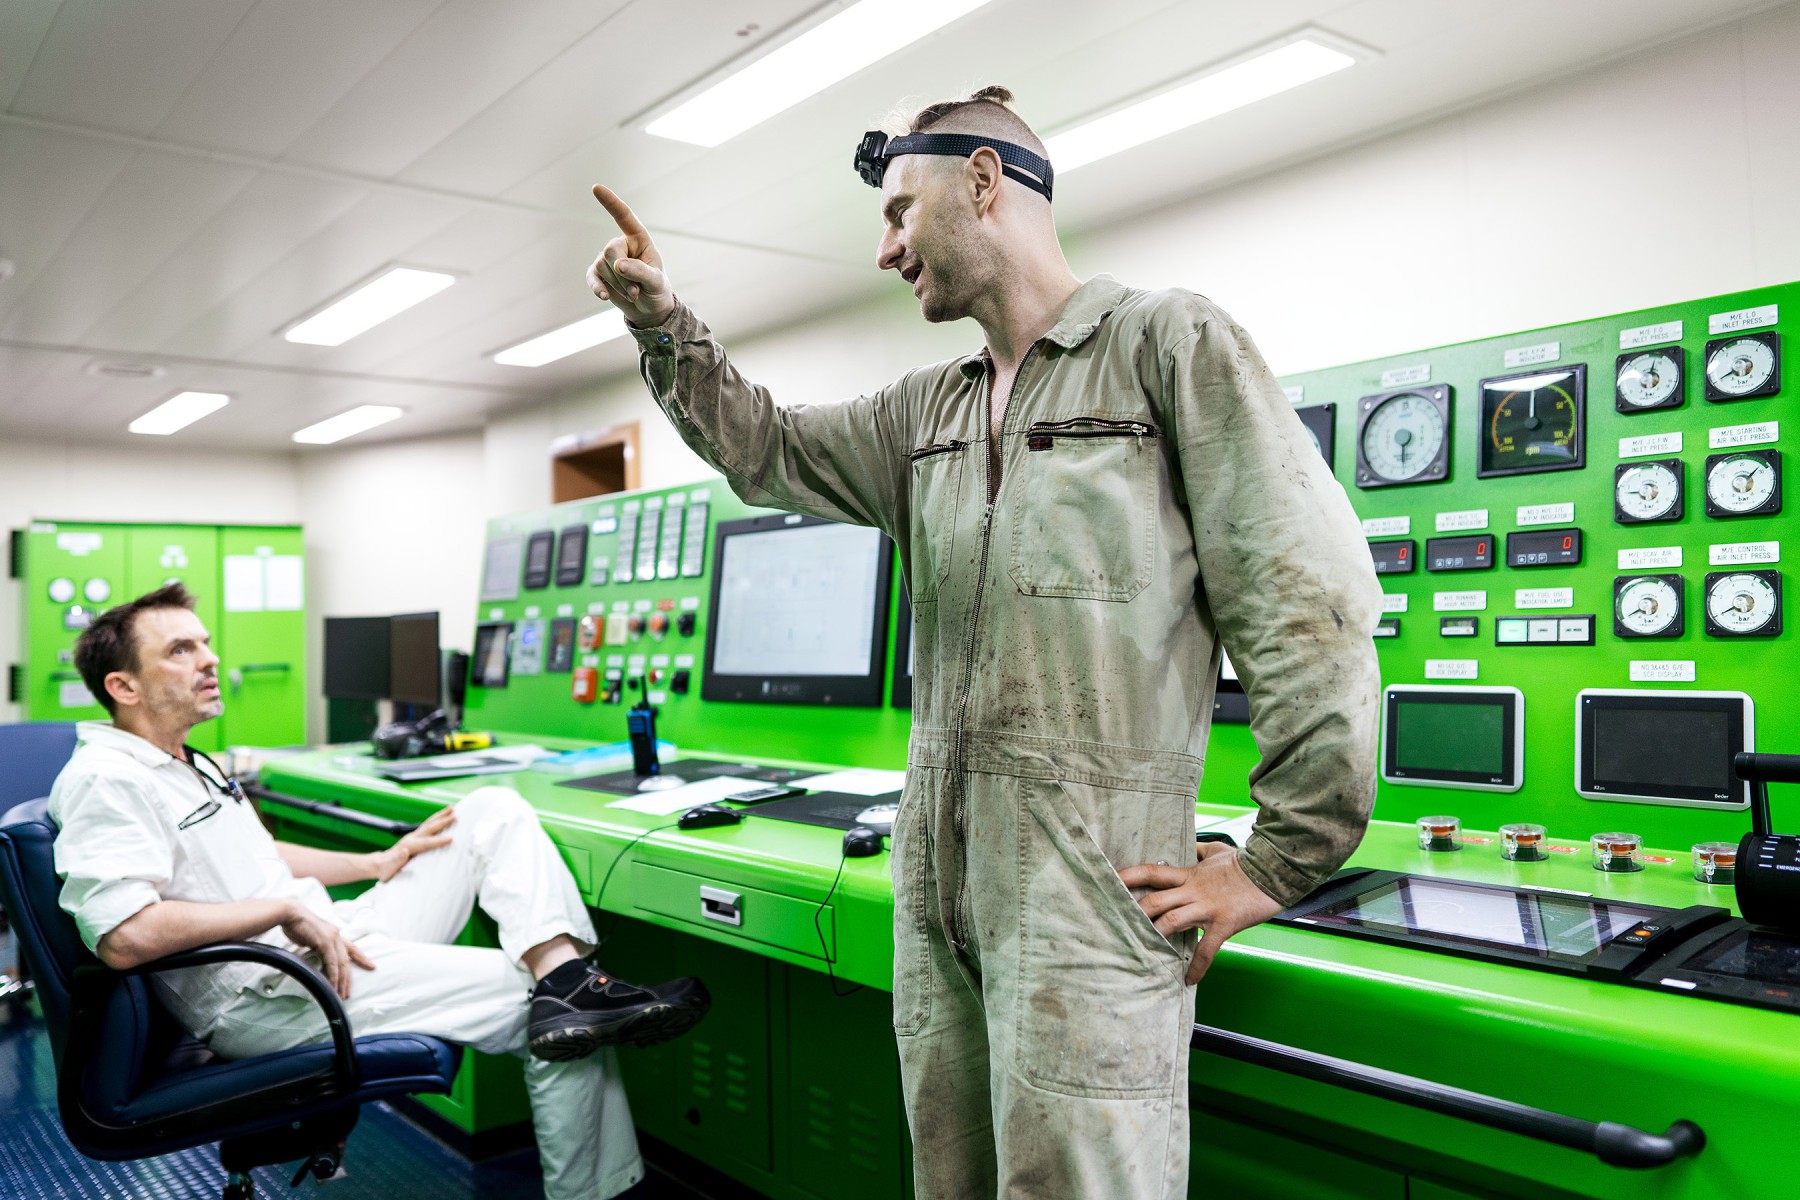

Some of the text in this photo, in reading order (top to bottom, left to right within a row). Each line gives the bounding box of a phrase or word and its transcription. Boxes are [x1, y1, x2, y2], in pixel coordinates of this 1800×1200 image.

[1722, 320, 1739, 329] INLET
[1632, 336, 1648, 344] INLET
[1721, 425, 1767, 437] M/E STARTING
[1730, 434, 1747, 443] INLET
[1525, 447, 1540, 456] rpm
[1562, 536, 1572, 550] 0
[1477, 542, 1486, 555] 0
[1737, 545, 1766, 553] CONTROL
[1398, 547, 1407, 560] 0
[1730, 553, 1747, 561] INLET
